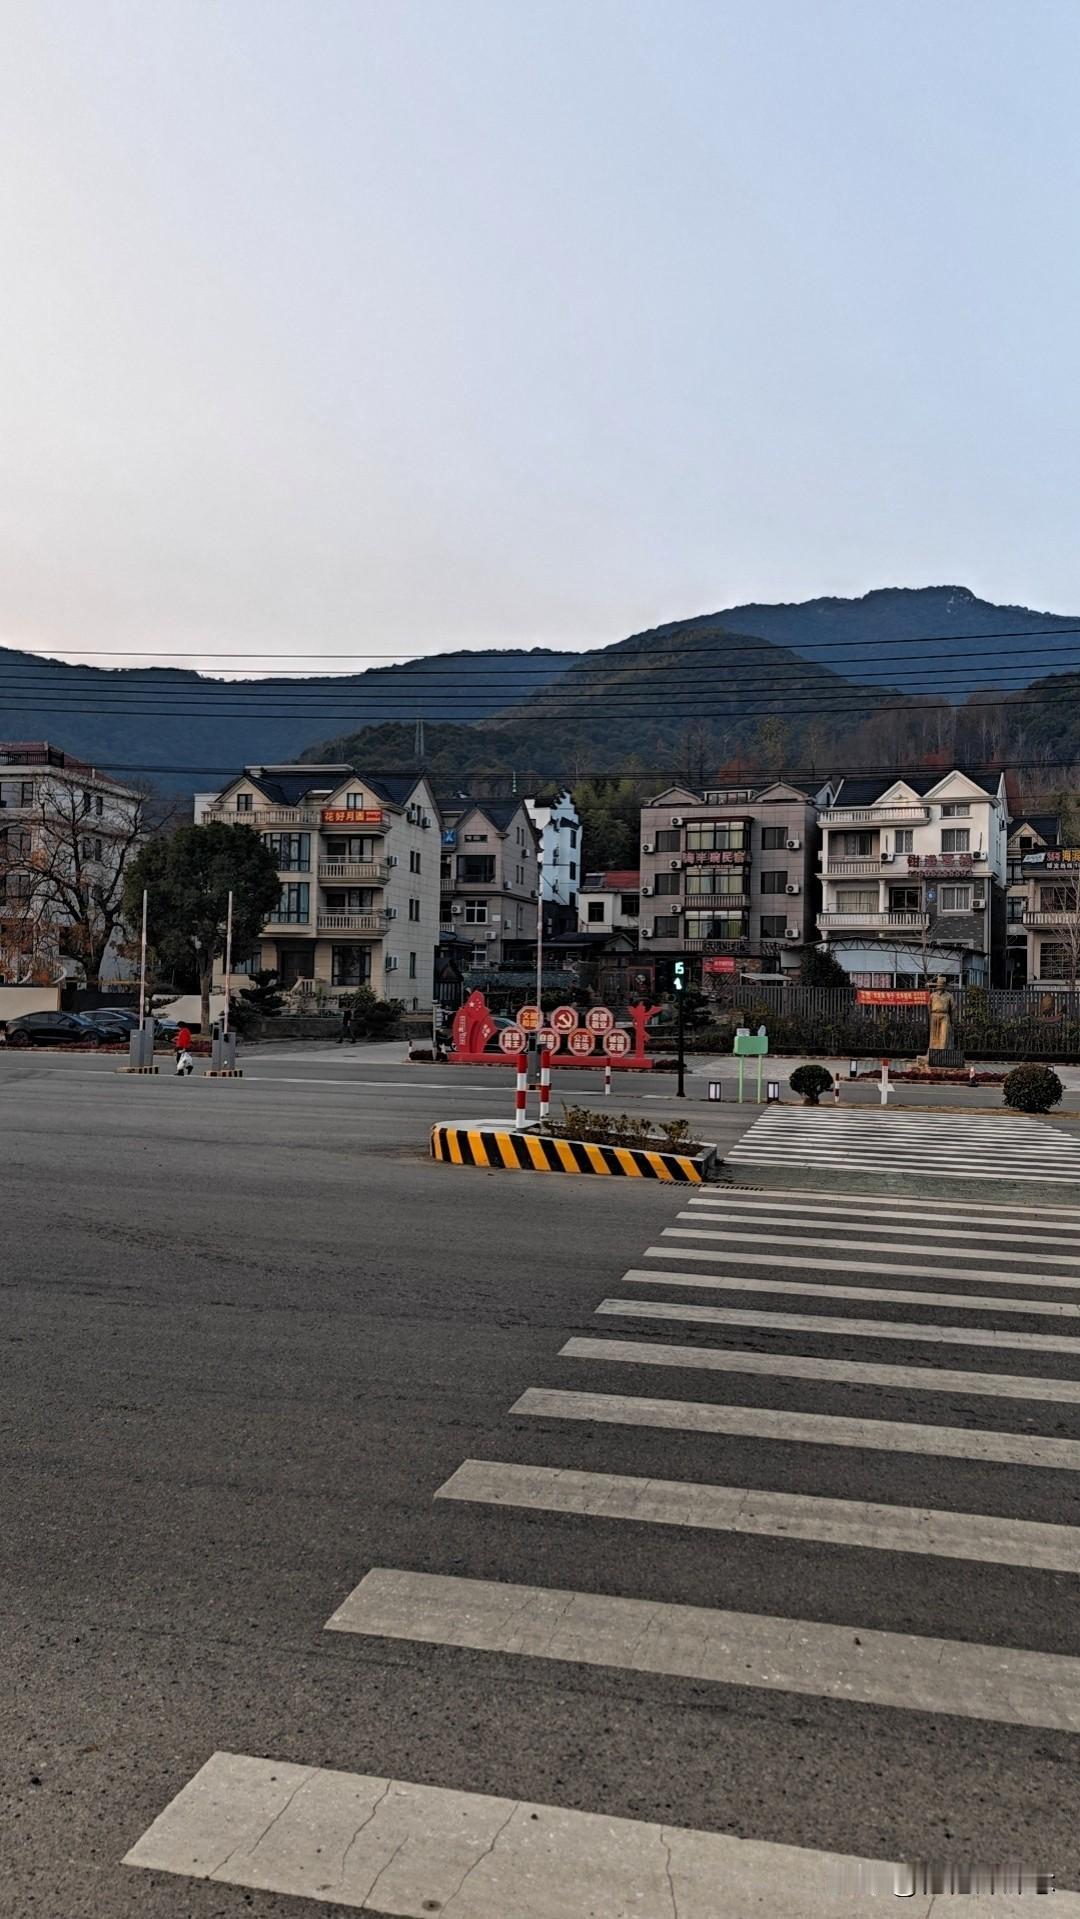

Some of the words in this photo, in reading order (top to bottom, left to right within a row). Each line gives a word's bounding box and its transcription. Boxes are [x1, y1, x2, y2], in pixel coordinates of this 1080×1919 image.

[324, 811, 365, 822] 花好月圆
[675, 962, 684, 974] 6
